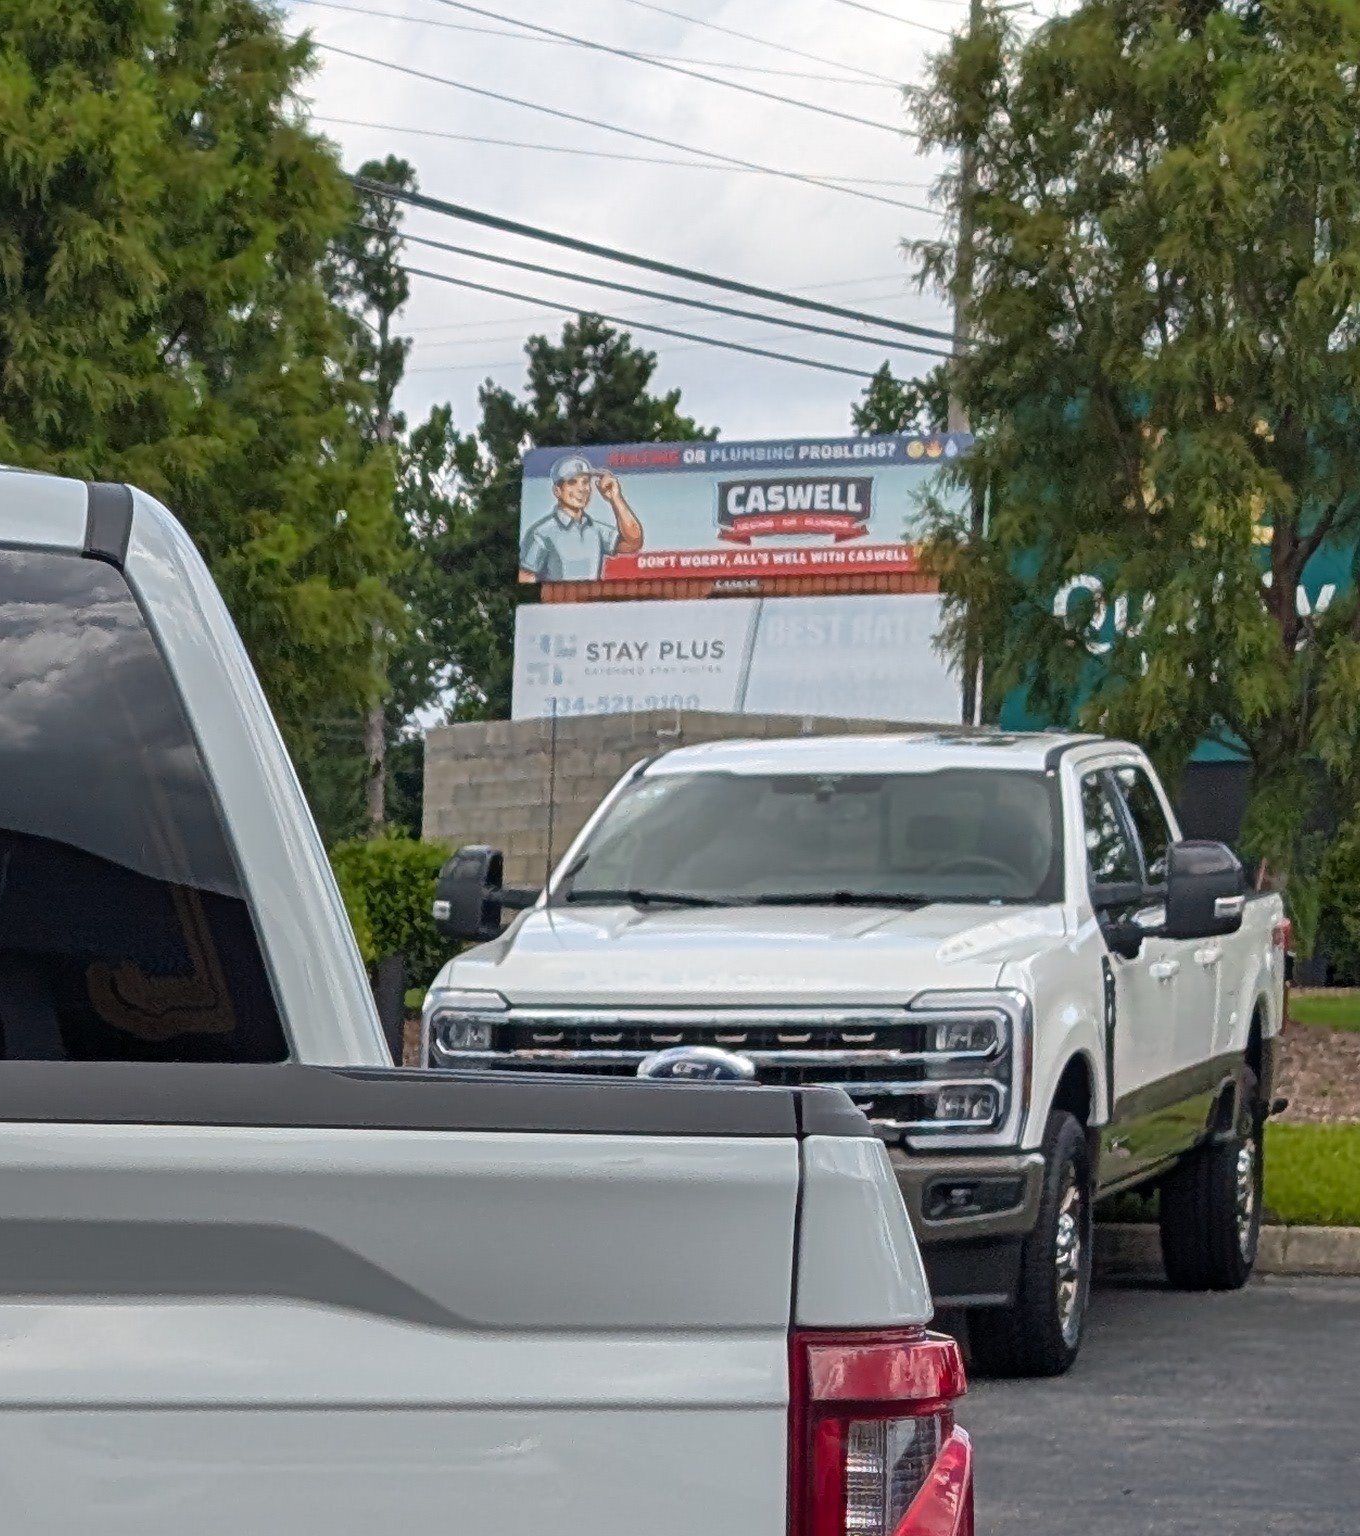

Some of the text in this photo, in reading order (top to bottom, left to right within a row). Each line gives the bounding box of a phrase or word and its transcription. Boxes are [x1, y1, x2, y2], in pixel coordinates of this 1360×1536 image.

[683, 449, 706, 464] OR
[798, 442, 896, 460] PROBLEMS?
[726, 483, 863, 515] CASWELL
[637, 550, 909, 569] DON'T WORRY, ALL'S WELL WITH CASWELL
[585, 640, 726, 662] STAY PLUS
